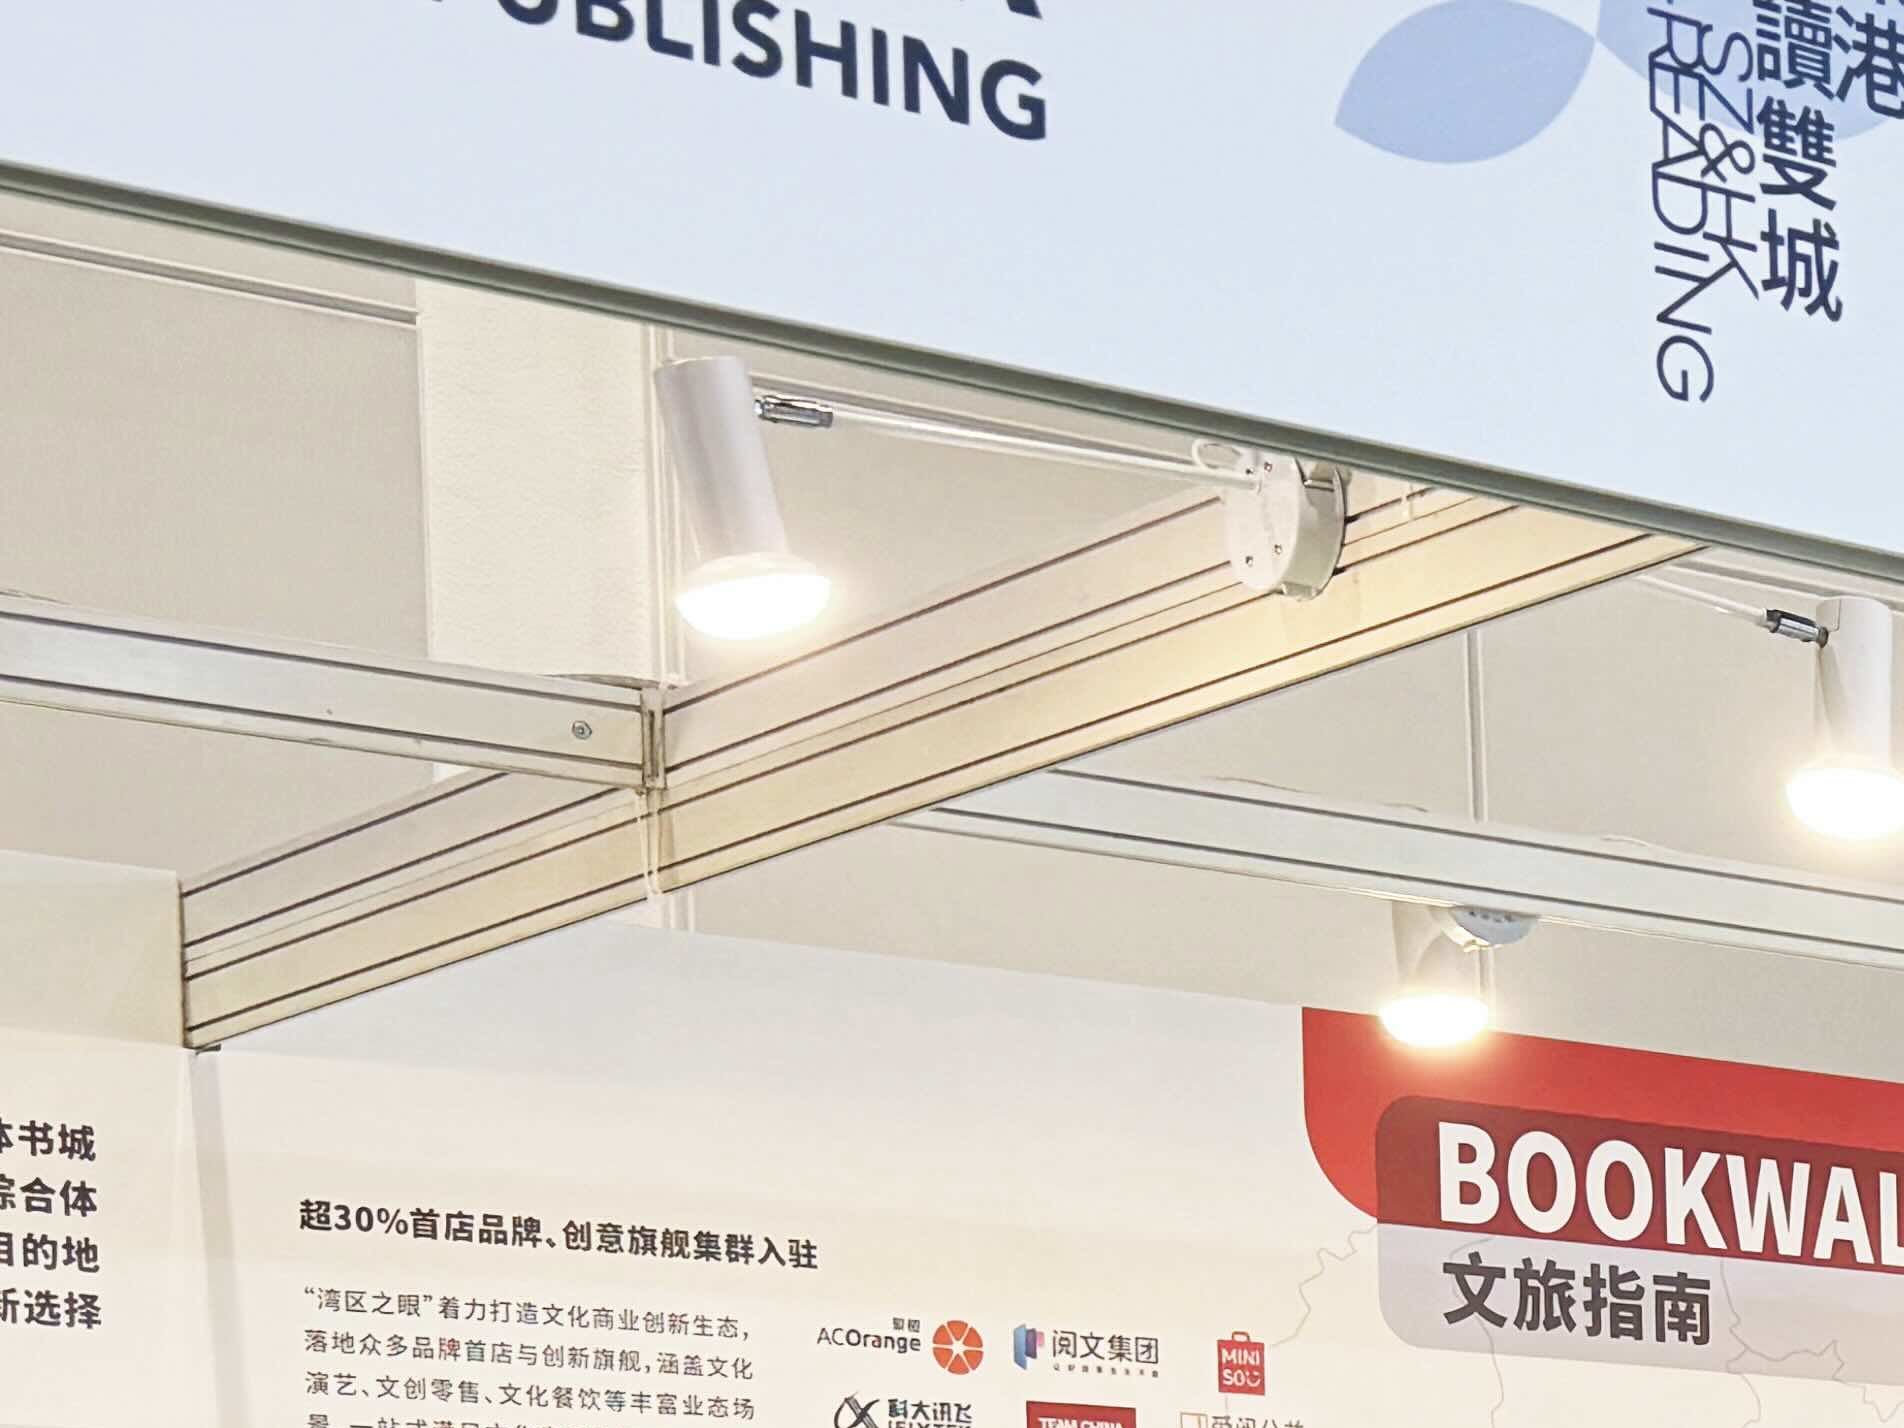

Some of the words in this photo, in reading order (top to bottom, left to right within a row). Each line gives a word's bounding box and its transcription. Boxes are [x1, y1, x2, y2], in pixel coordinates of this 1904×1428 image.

[434, 0, 1046, 140] BLISHING
[1700, 31, 1759, 300] SZ&HK
[299, 1199, 818, 1269] 超30%首店品牌、创意旗舰集群入驻
[1441, 1251, 1713, 1346] 文旅指南
[817, 1328, 921, 1353] ACOrange
[1053, 1330, 1159, 1364] 阅文集团
[1221, 1348, 1260, 1366] MINI
[888, 1398, 972, 1424] 科大讯飞
